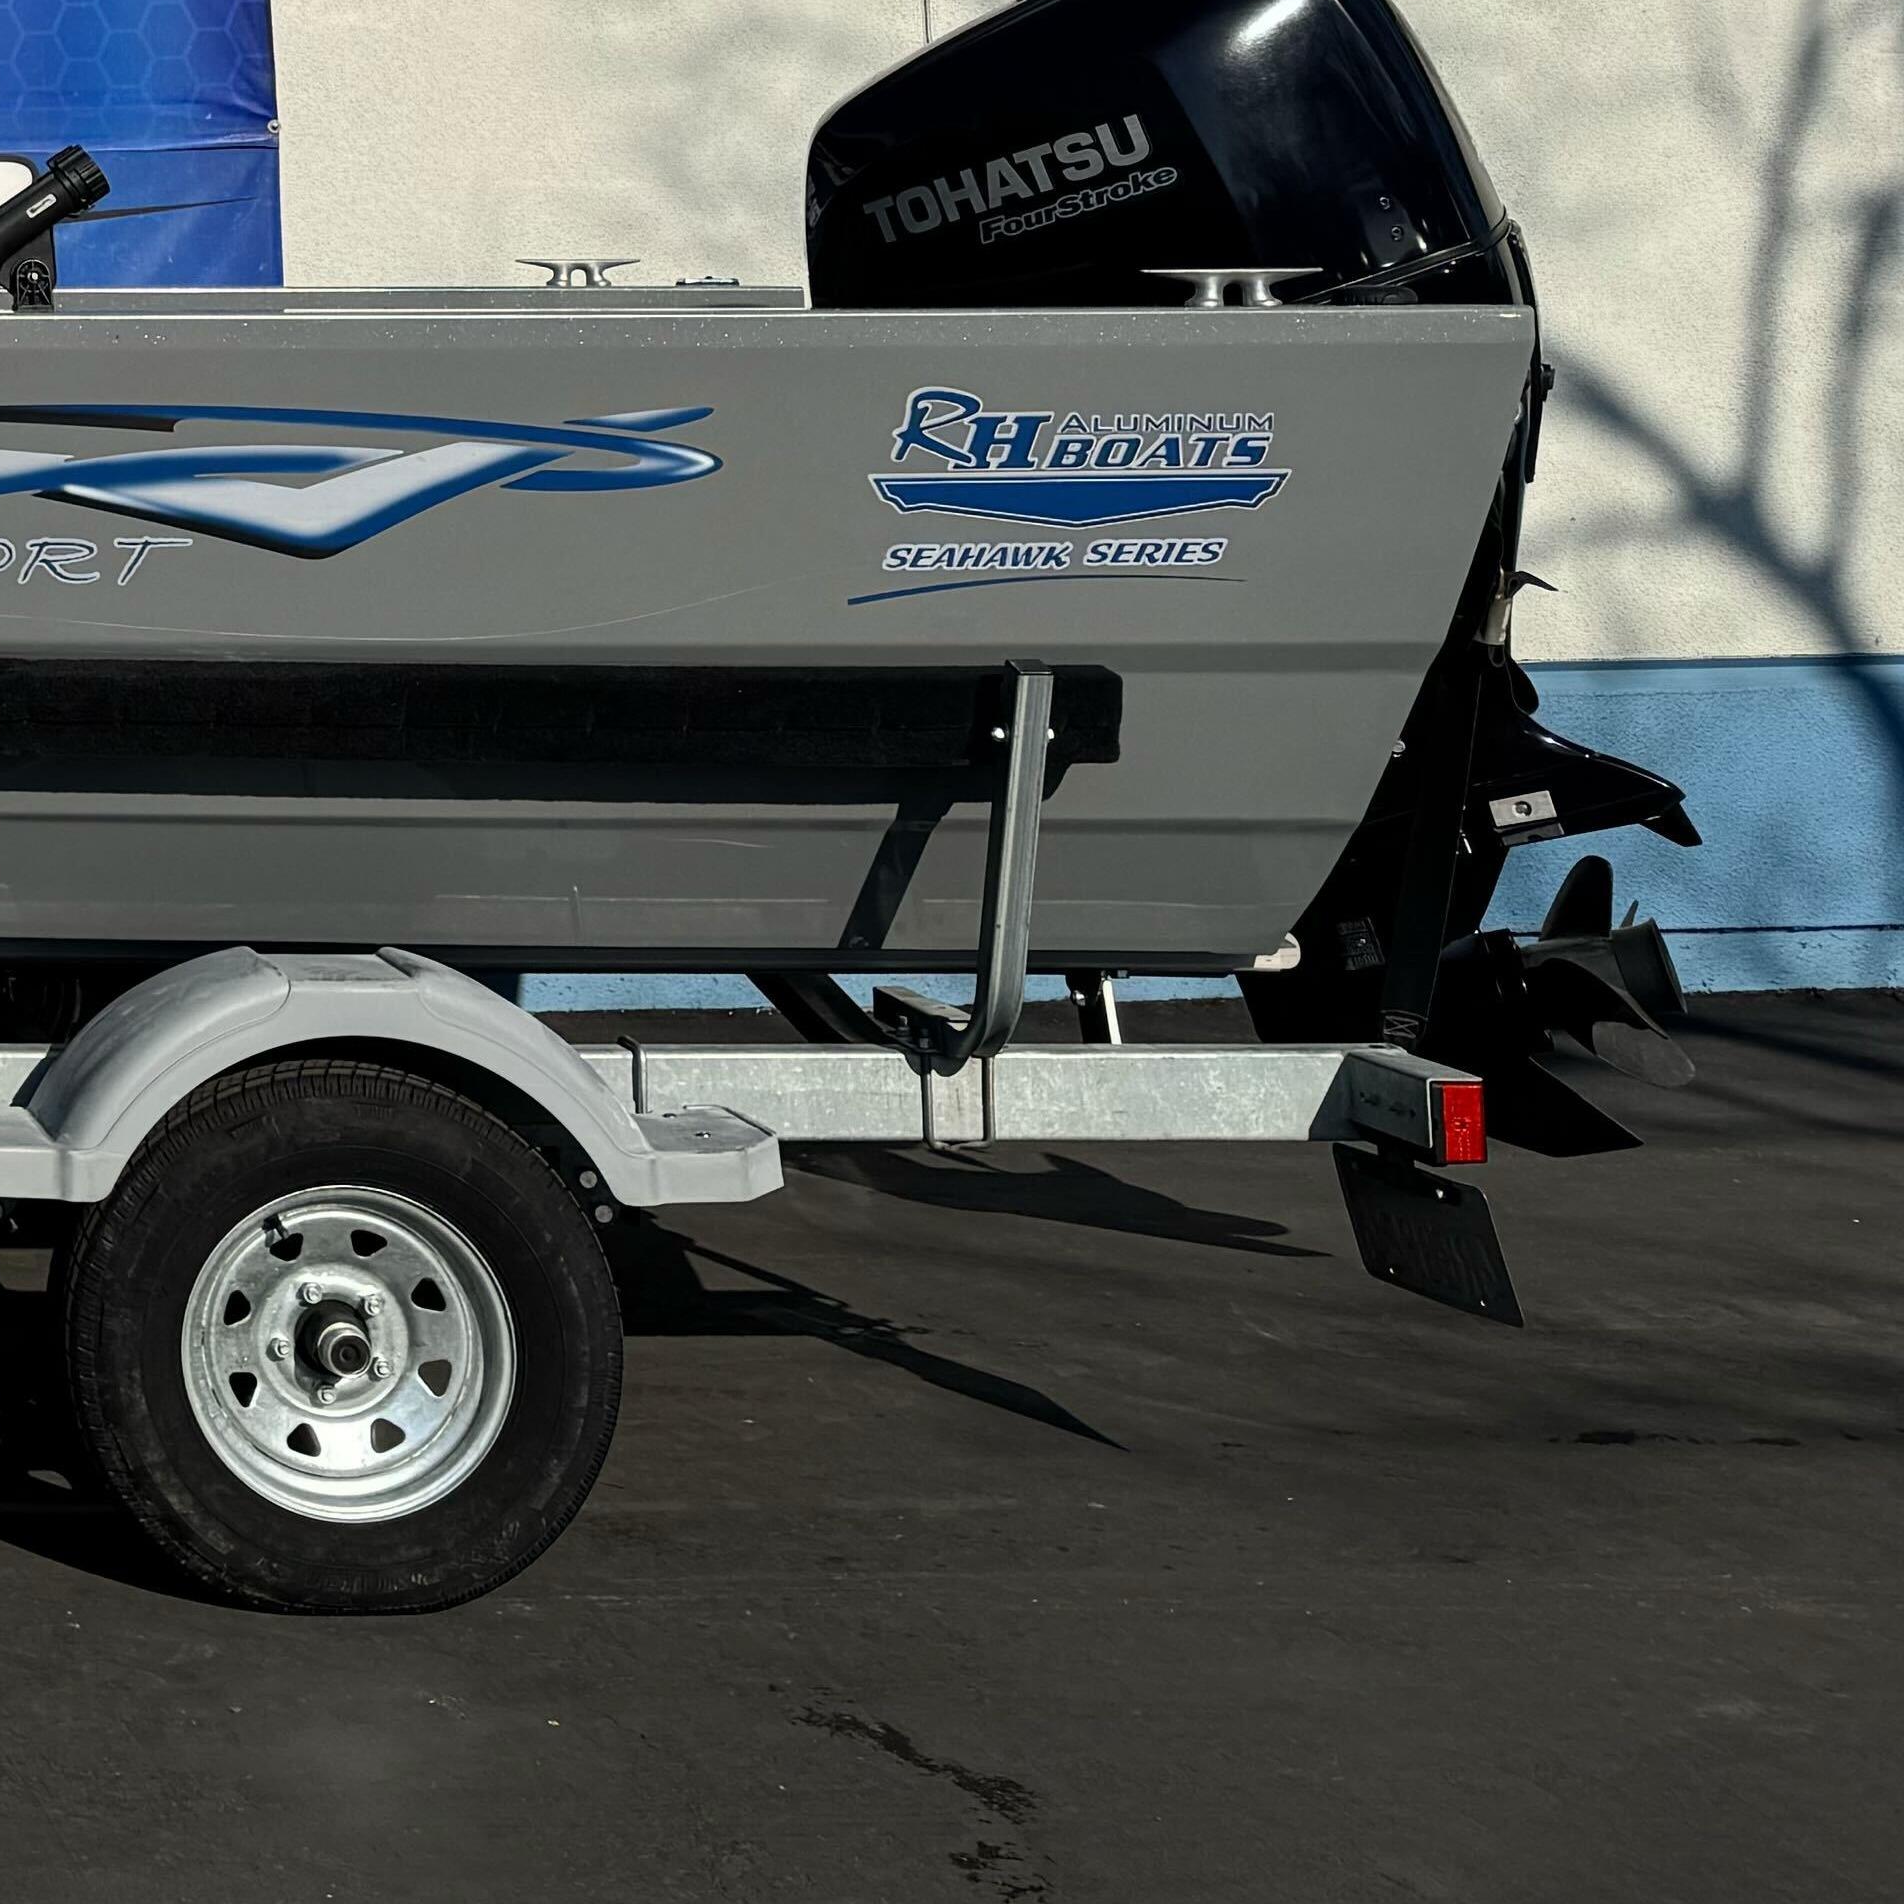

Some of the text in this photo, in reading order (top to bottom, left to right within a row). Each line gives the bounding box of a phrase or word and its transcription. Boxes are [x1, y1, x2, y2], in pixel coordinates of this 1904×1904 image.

[864, 114, 1154, 243] TOHATSU
[980, 165, 1178, 244] FourStroke
[893, 387, 1275, 471] RH ALUMINUM
[1045, 434, 1273, 469] BOATS
[883, 538, 1228, 571] SEAHAWK SERIES
